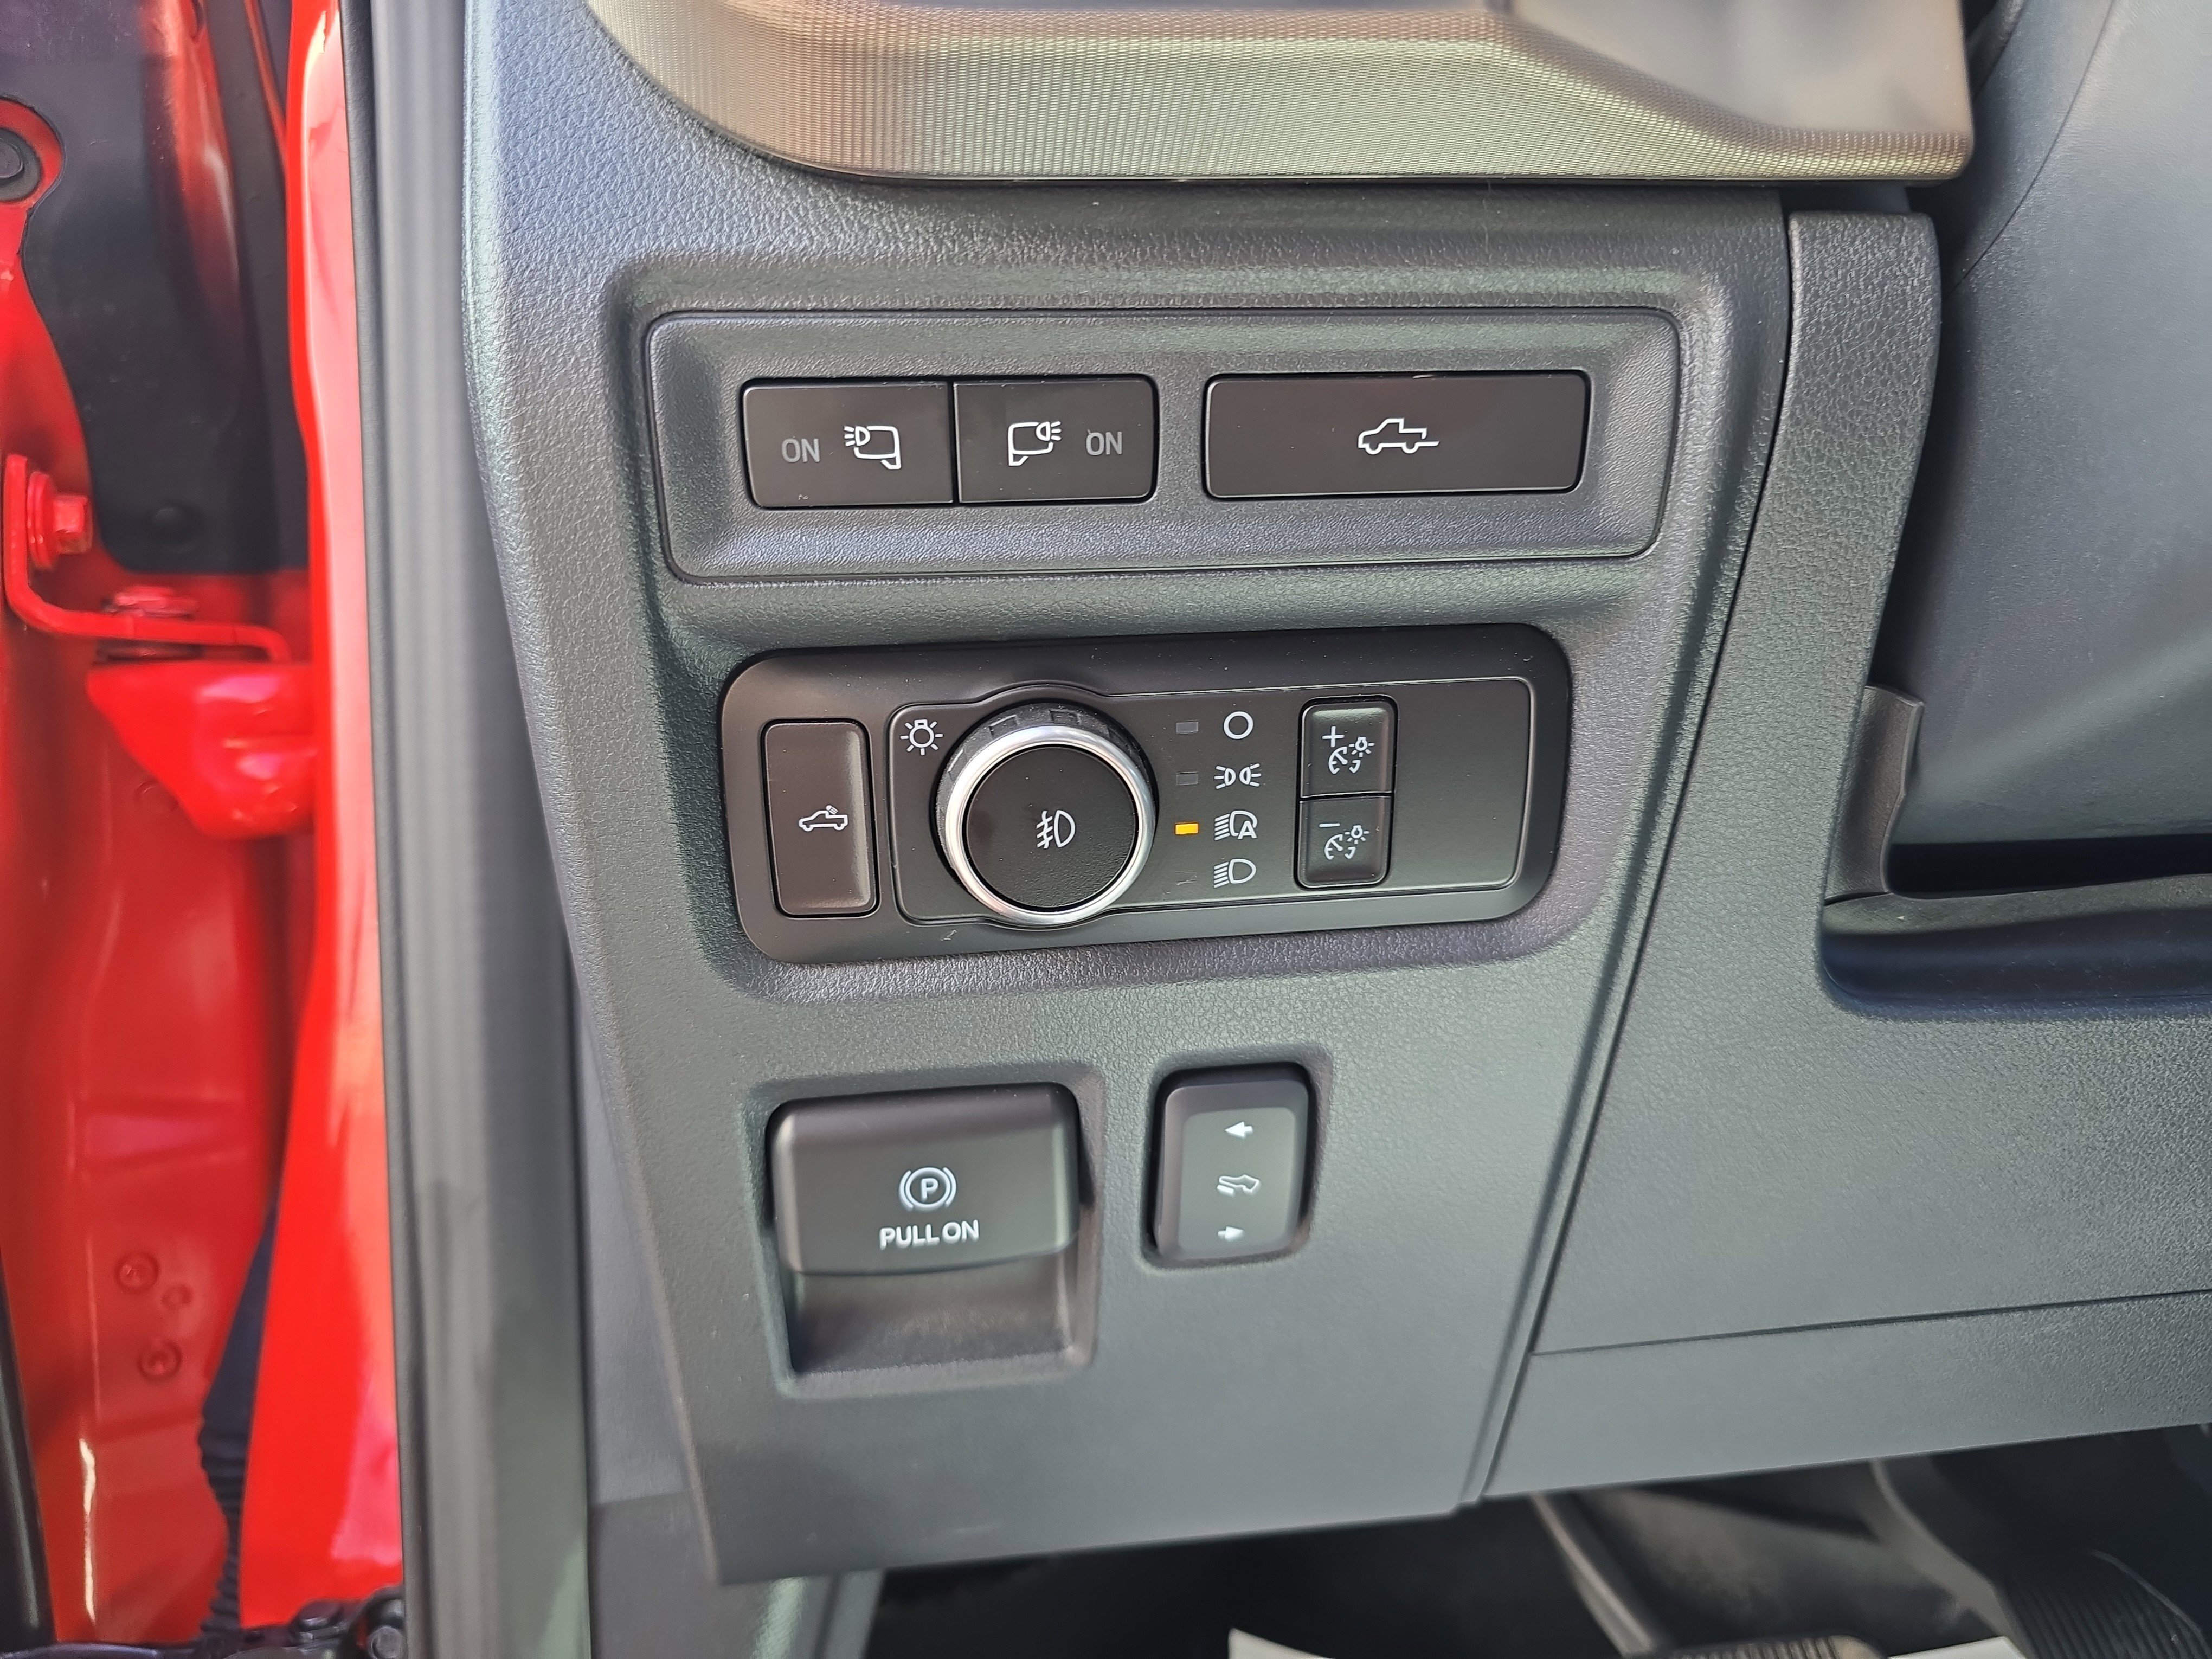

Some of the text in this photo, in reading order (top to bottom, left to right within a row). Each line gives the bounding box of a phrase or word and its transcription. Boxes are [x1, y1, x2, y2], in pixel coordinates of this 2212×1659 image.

[781, 437, 820, 462] ON
[1086, 432, 1122, 455] ON
[921, 1178, 939, 1200] P
[879, 1219, 980, 1250] PULL ON
